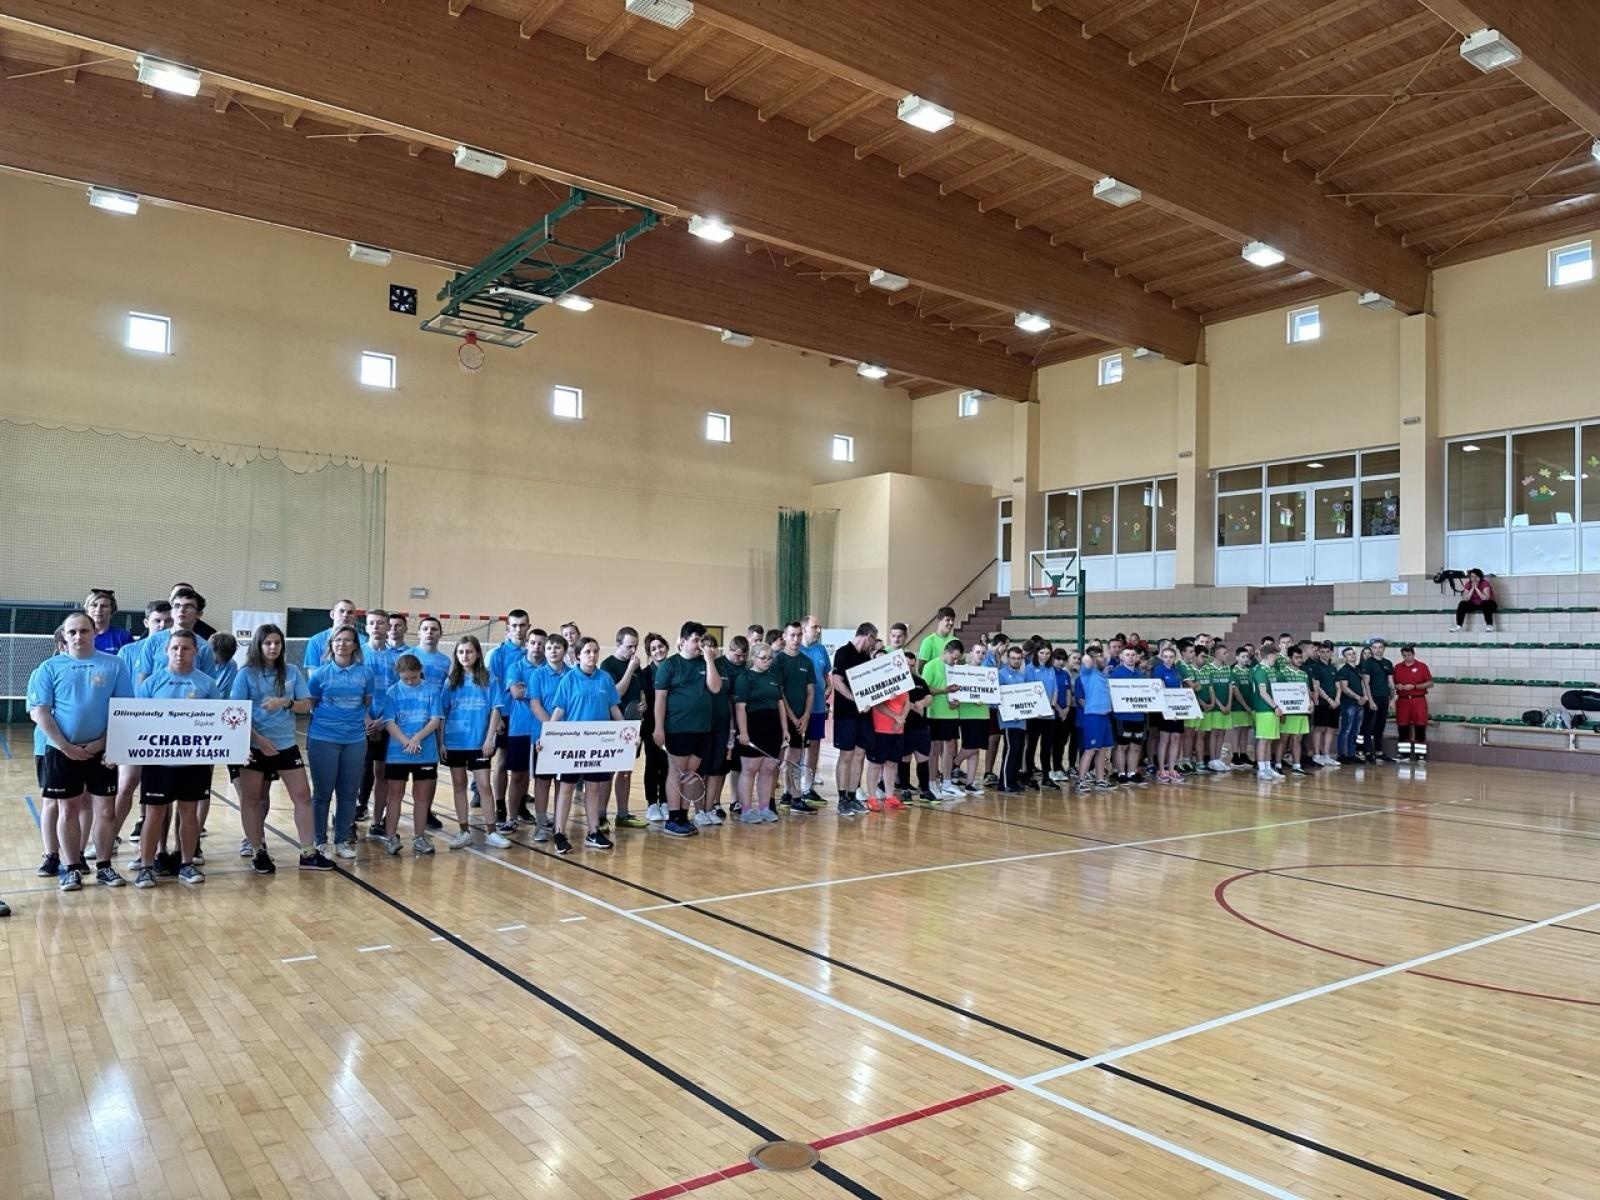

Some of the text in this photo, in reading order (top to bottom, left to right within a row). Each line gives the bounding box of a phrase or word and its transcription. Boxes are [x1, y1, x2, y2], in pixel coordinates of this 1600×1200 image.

[959, 685, 998, 694] ONICZYNKA"
[113, 709, 215, 718] Olimpiady Specjalne
[137, 734, 223, 746] "CHABRY"
[128, 746, 230, 759] WODZISŁAW ŚLĄSKI
[553, 748, 624, 760] "FAIR PLAY"
[573, 760, 602, 768] RYBNIK
